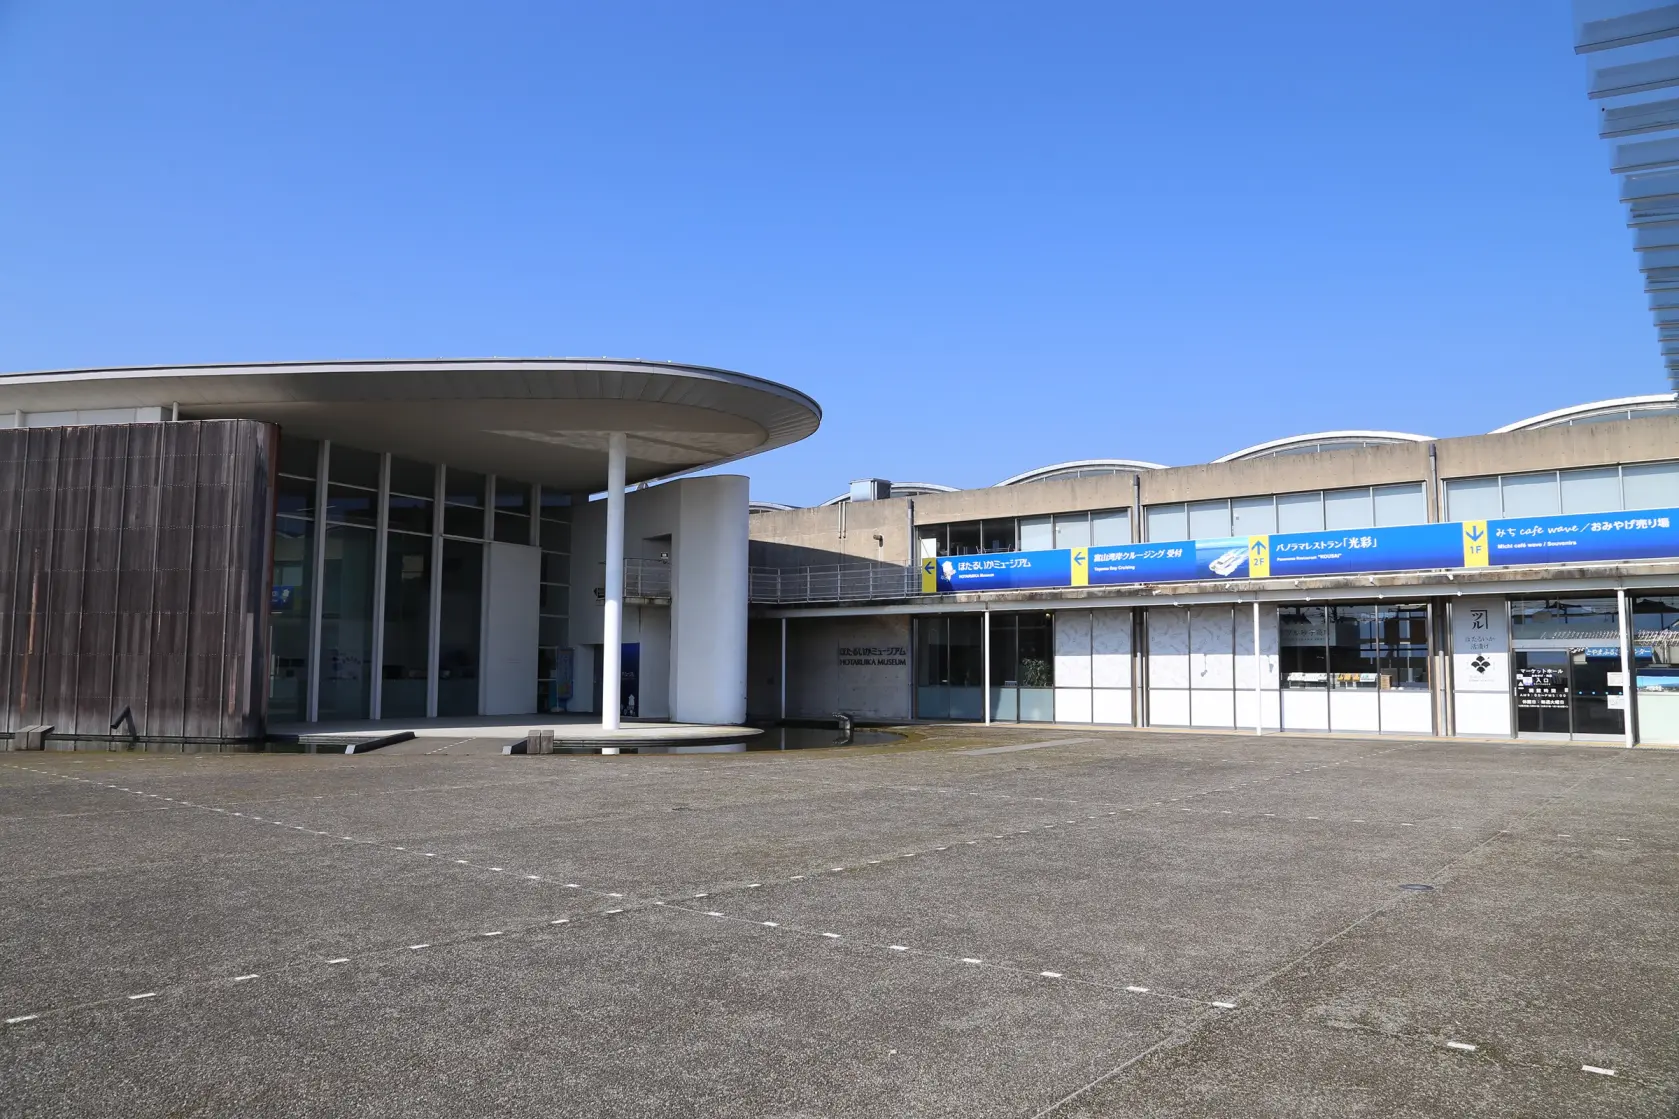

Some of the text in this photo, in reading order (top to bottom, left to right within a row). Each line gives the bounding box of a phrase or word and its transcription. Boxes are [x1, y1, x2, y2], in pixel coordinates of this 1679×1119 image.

[1496, 528, 1516, 537] みち
[1520, 525, 1544, 536] cafe
[1547, 525, 1579, 534] wave
[1276, 536, 1378, 551] パノラマレストラン「光彩」
[1093, 549, 1183, 562] 富山湾岸クルージング 受付
[1470, 546, 1482, 554] 1F
[958, 558, 1031, 571] ほたるいかミュージアム
[1253, 558, 1265, 566] 2F
[839, 647, 907, 656] ほたるいかミュージアム
